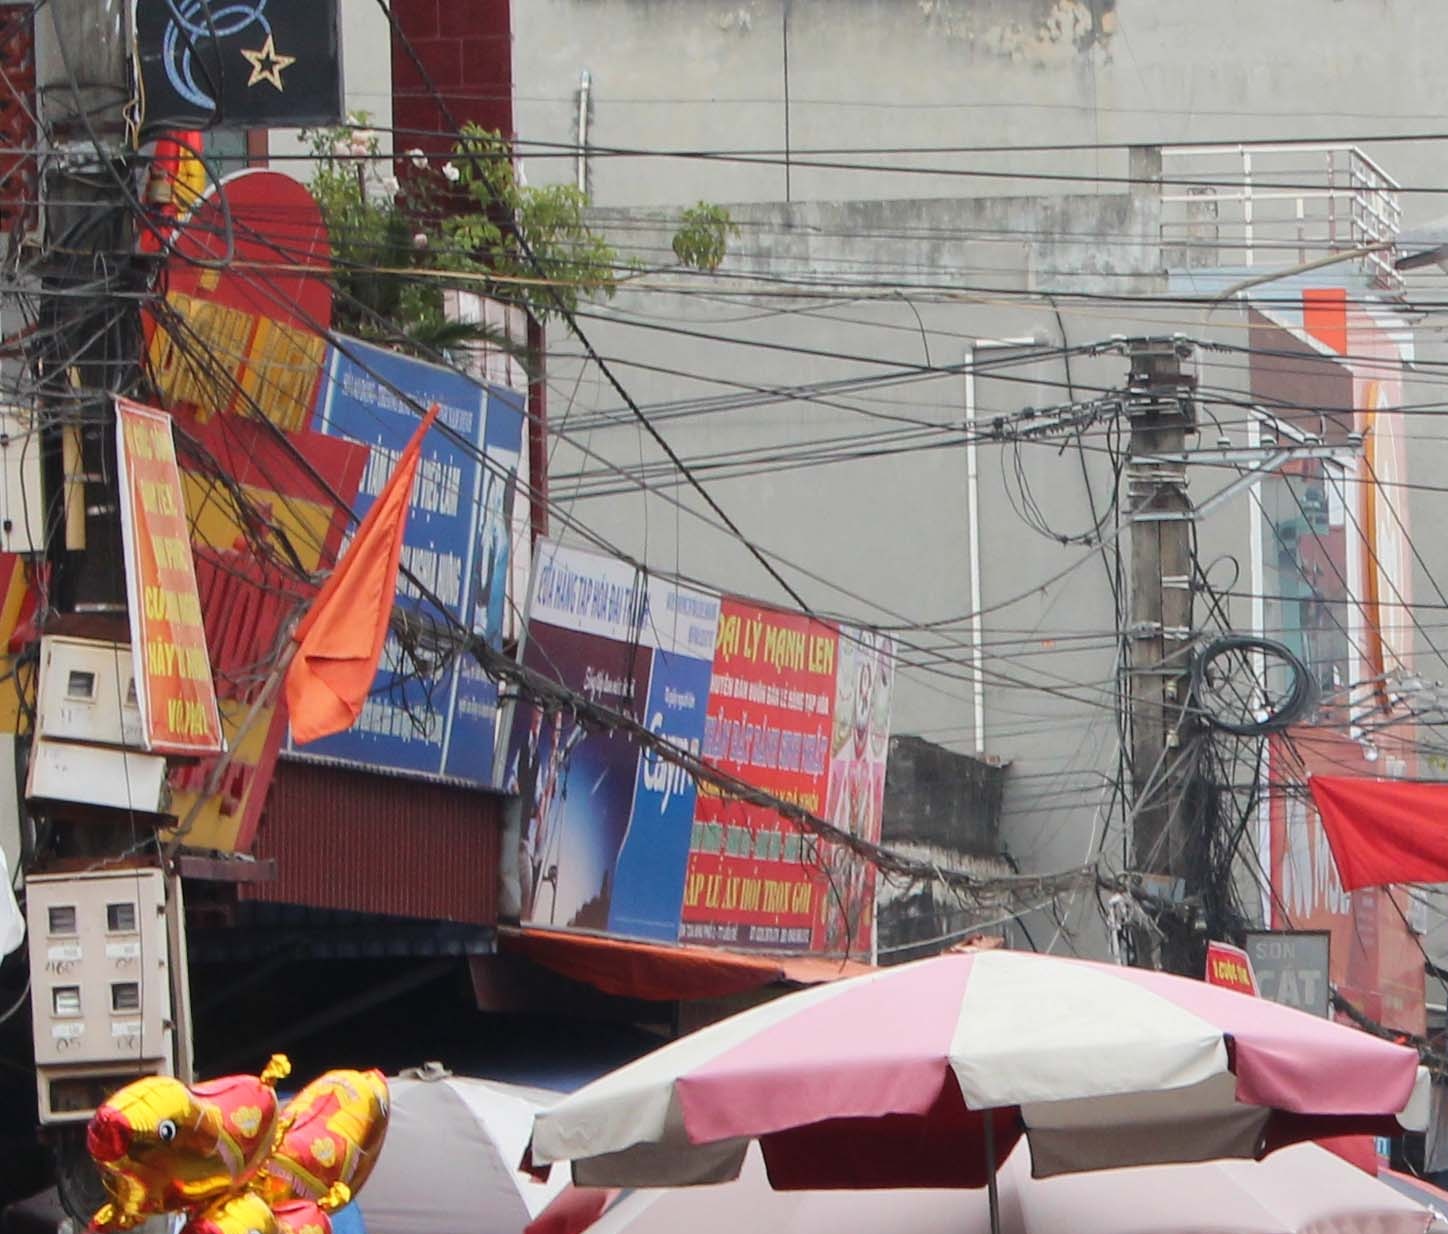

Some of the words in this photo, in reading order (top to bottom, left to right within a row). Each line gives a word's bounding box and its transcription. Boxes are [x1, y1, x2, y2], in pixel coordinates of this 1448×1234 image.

[743, 612, 763, 663] LÝ
[765, 625, 805, 675] MẠNH
[808, 634, 835, 676] LEN
